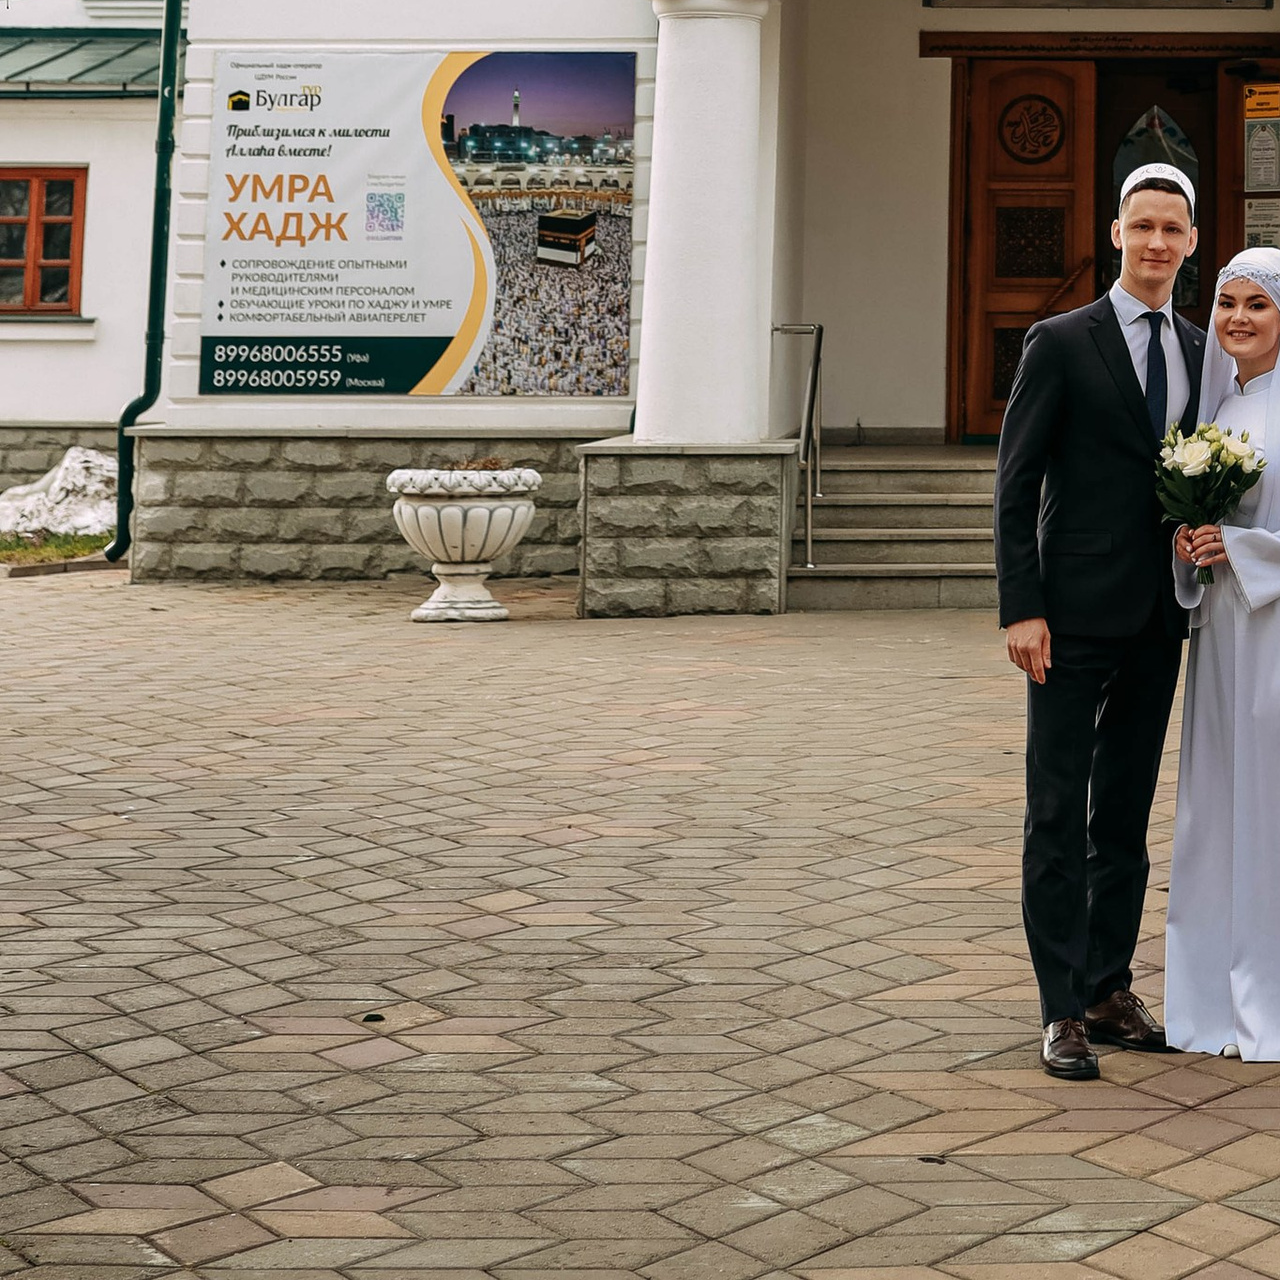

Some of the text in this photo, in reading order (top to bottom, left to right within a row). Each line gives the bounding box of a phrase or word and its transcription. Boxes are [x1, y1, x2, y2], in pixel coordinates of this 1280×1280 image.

[256, 90, 322, 111] Булгар
[226, 125, 390, 140] Приблизимся к милости
[278, 144, 332, 158] вместе!
[225, 174, 335, 203] УМРА
[222, 212, 349, 247] ХАДЖ
[232, 259, 407, 270] СОПРОВОЖДЕНИЕ ОПЫТНЫМИ
[231, 273, 339, 283] РУКОВОДИТЕЛЯМИ
[231, 286, 415, 297] И МЕДИЦИНСКИМ ПЕРСОНАЛОМ
[230, 300, 453, 311] ОБУЧАЮЩИЕ УРОКИ ПО ХАДЖУ И УМРЕ
[229, 311, 426, 323] КОМФОРТАБЕЛЬНЫЙ АВИАПЕРЕЛЕТ
[214, 345, 370, 363] 89968006555 (Уфа)
[213, 370, 385, 388] 89968005959 (Москва)
